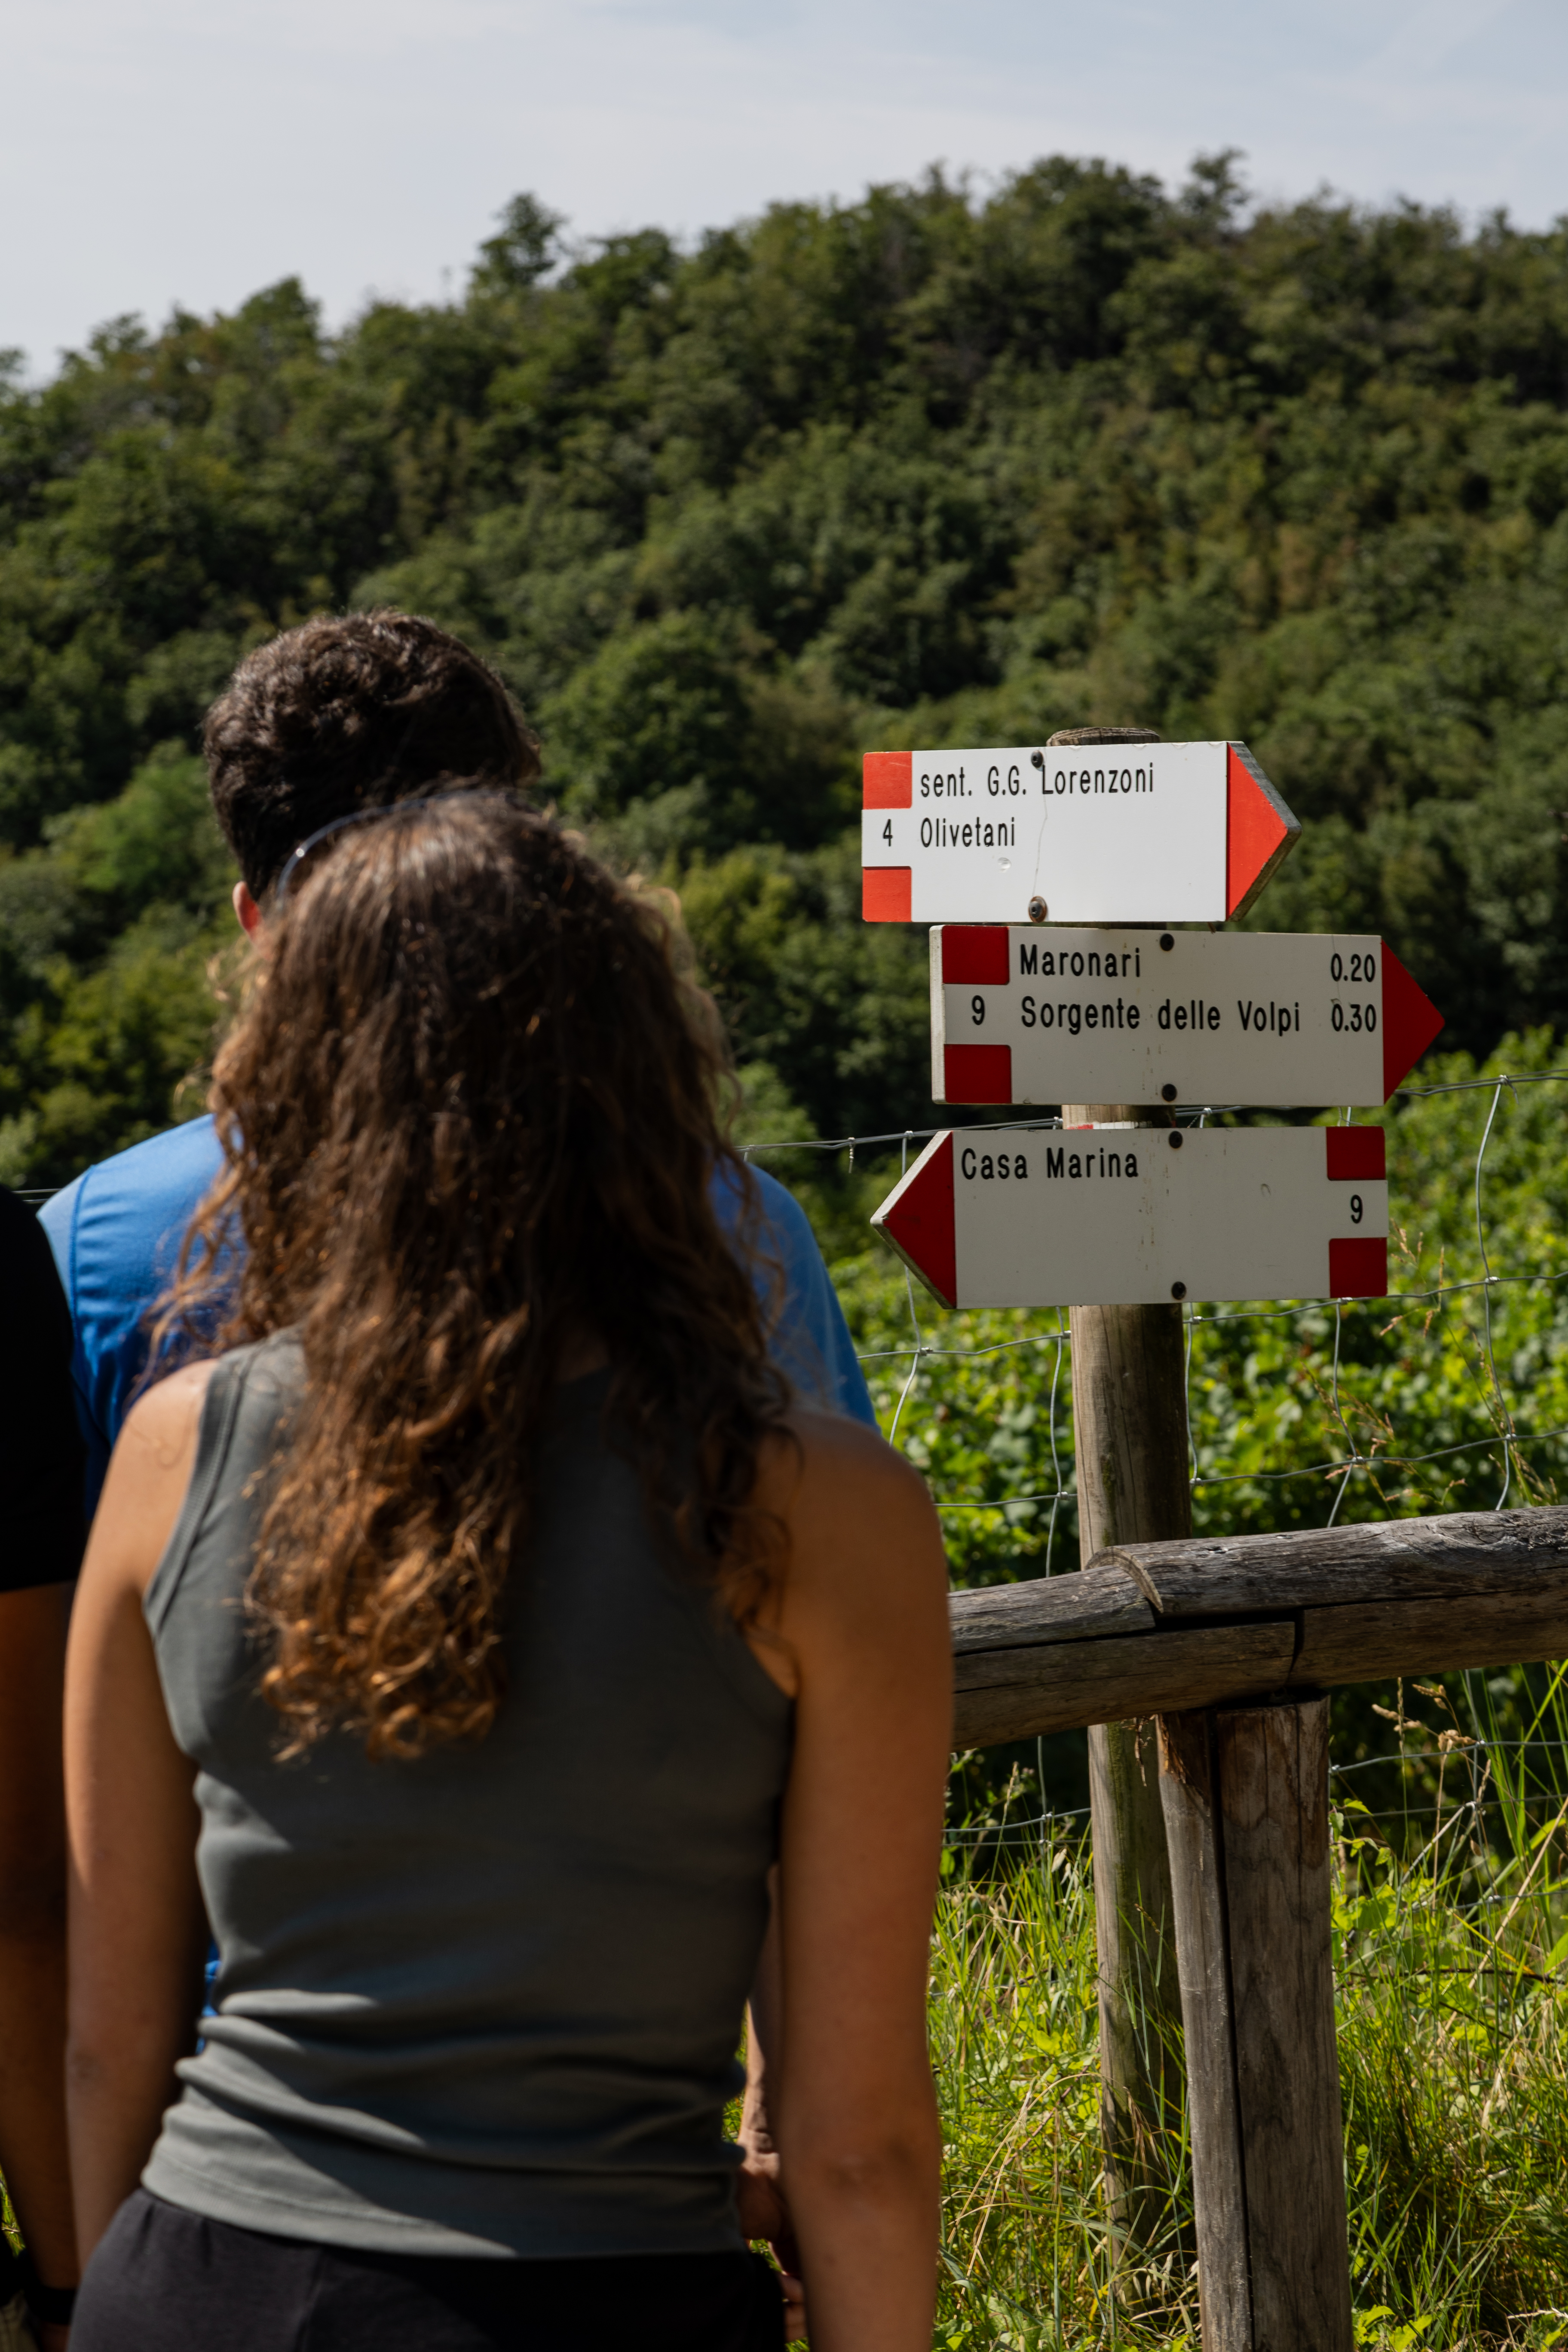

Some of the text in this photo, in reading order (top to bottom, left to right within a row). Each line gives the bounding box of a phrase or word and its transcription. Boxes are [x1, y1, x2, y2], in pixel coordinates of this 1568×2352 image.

[920, 762, 1154, 798] sent. G.G. Lorenzoni
[882, 819, 893, 847] 4
[920, 816, 1015, 848] Olivetani
[1020, 943, 1376, 983] Maronari 0.20
[971, 995, 986, 1026] 9
[1021, 995, 1377, 1037] Sorgente delle Volpi 0.30
[961, 1146, 1139, 1180] Casa Marina
[1350, 1194, 1363, 1225] 9
